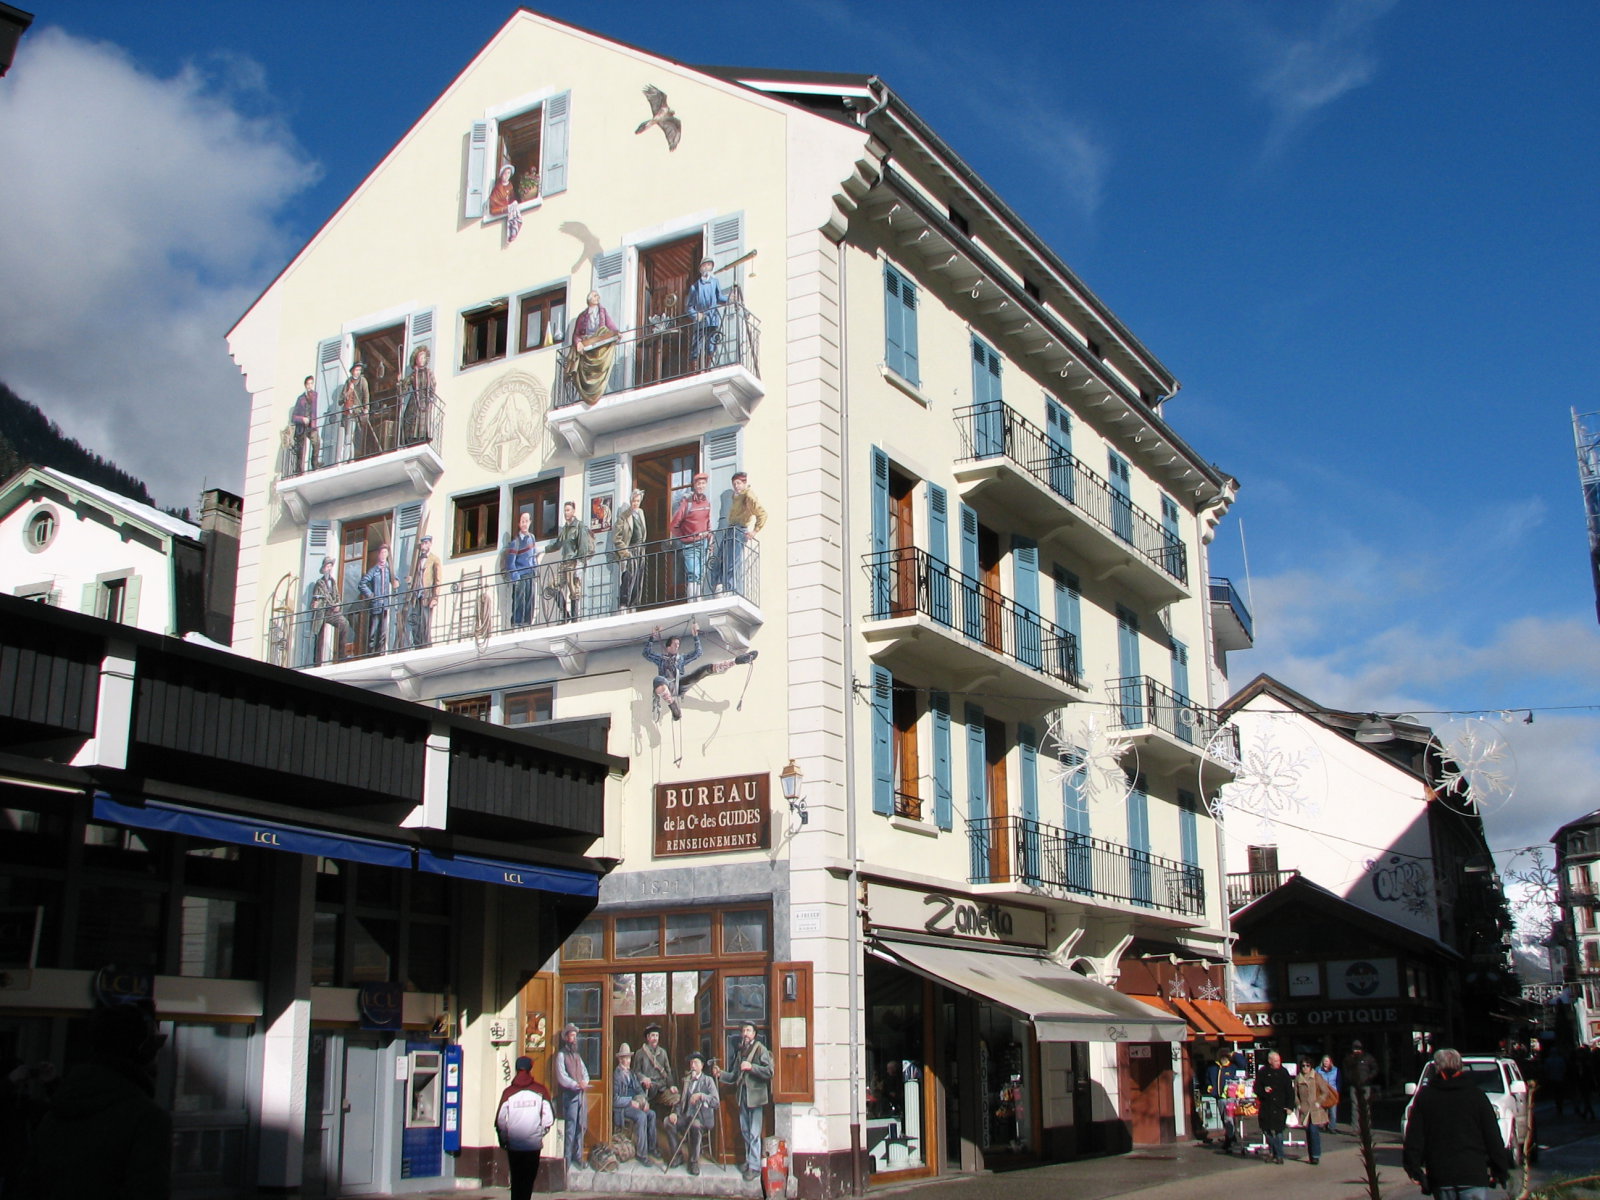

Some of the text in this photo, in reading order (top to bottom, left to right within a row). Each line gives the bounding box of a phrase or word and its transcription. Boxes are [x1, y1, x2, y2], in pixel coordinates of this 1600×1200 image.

[665, 781, 757, 809] BUREAU
[664, 816, 675, 831] de
[677, 816, 685, 830] la
[700, 813, 716, 828] des
[718, 808, 761, 827] GUIDES
[254, 831, 281, 846] LCL
[666, 833, 757, 851] RENSEIGNEMENTS
[504, 872, 524, 884] LCL
[923, 893, 1013, 937] Zanetta
[1308, 1008, 1398, 1024] OPTIQUE
